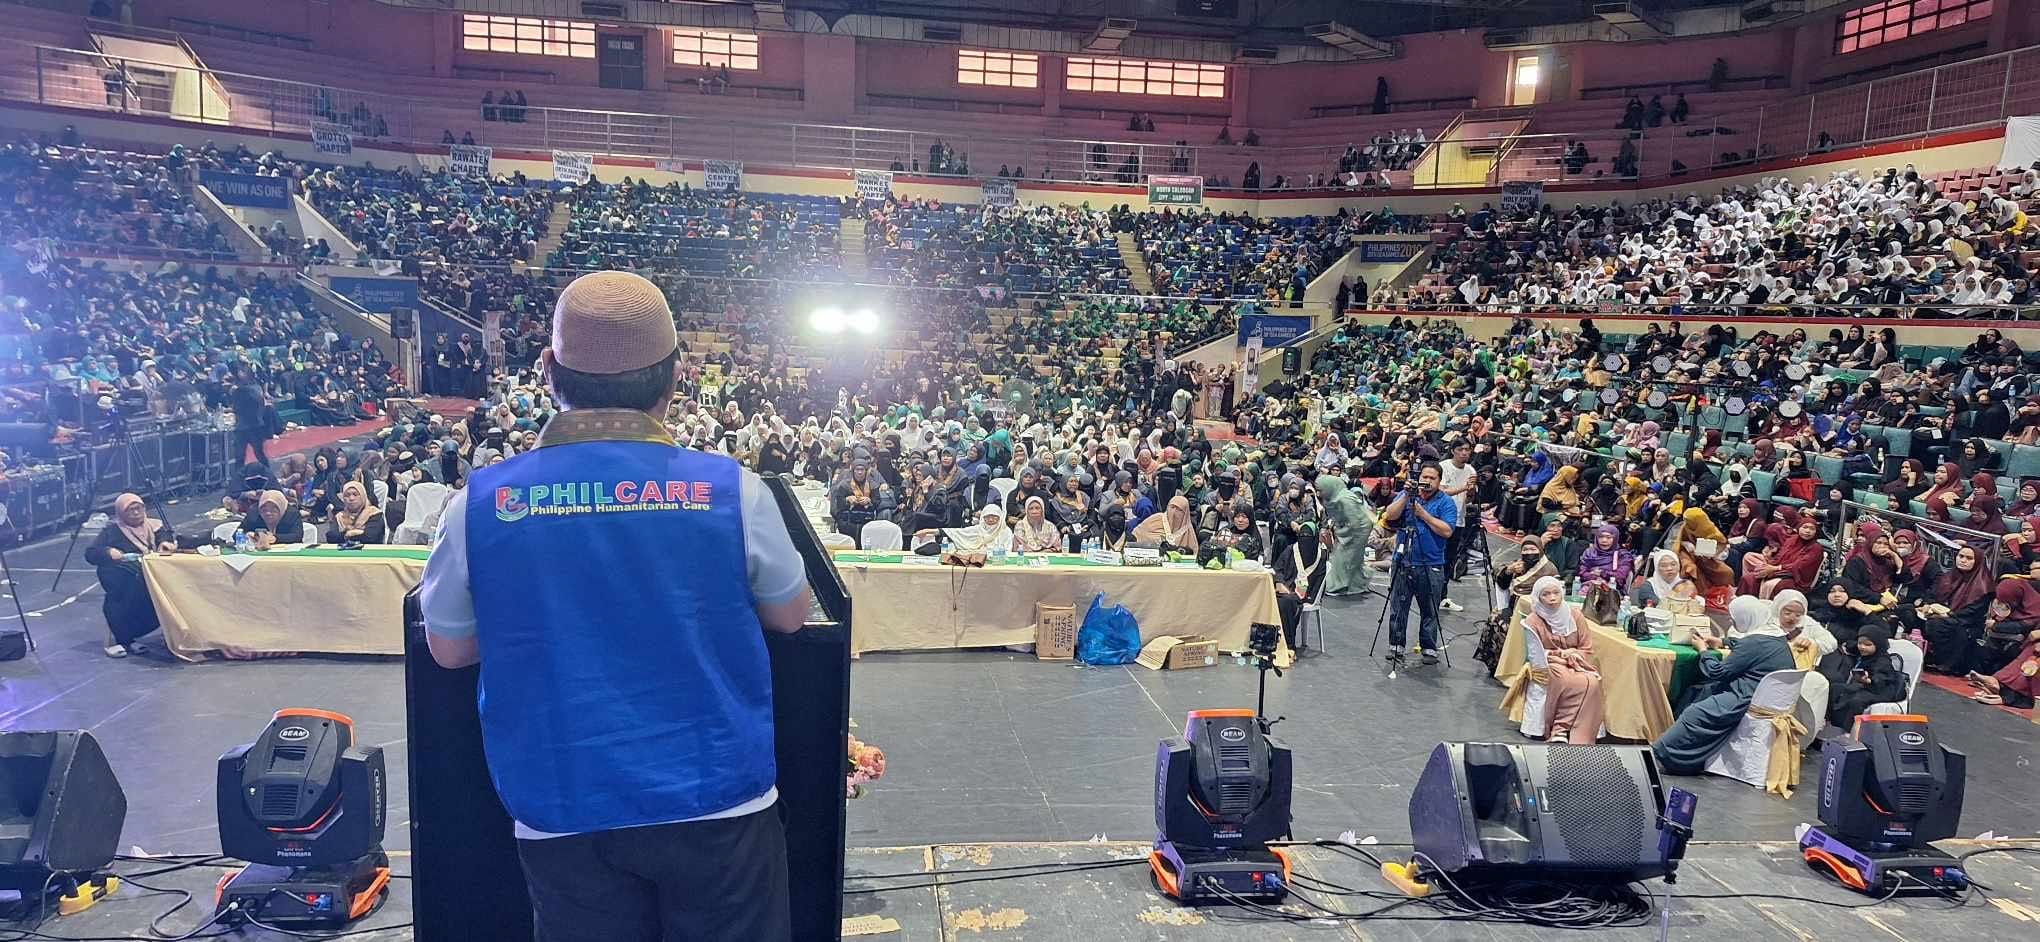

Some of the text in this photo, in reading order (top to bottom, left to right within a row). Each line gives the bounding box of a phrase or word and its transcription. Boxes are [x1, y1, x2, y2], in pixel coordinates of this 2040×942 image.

[208, 180, 285, 198] WE WIN AS ONE
[858, 178, 888, 187] MARKET
[1367, 243, 1400, 252] PHILIPPINES
[529, 480, 713, 507] PHILCARE
[530, 500, 710, 516] Philippine Humanitarian Care
